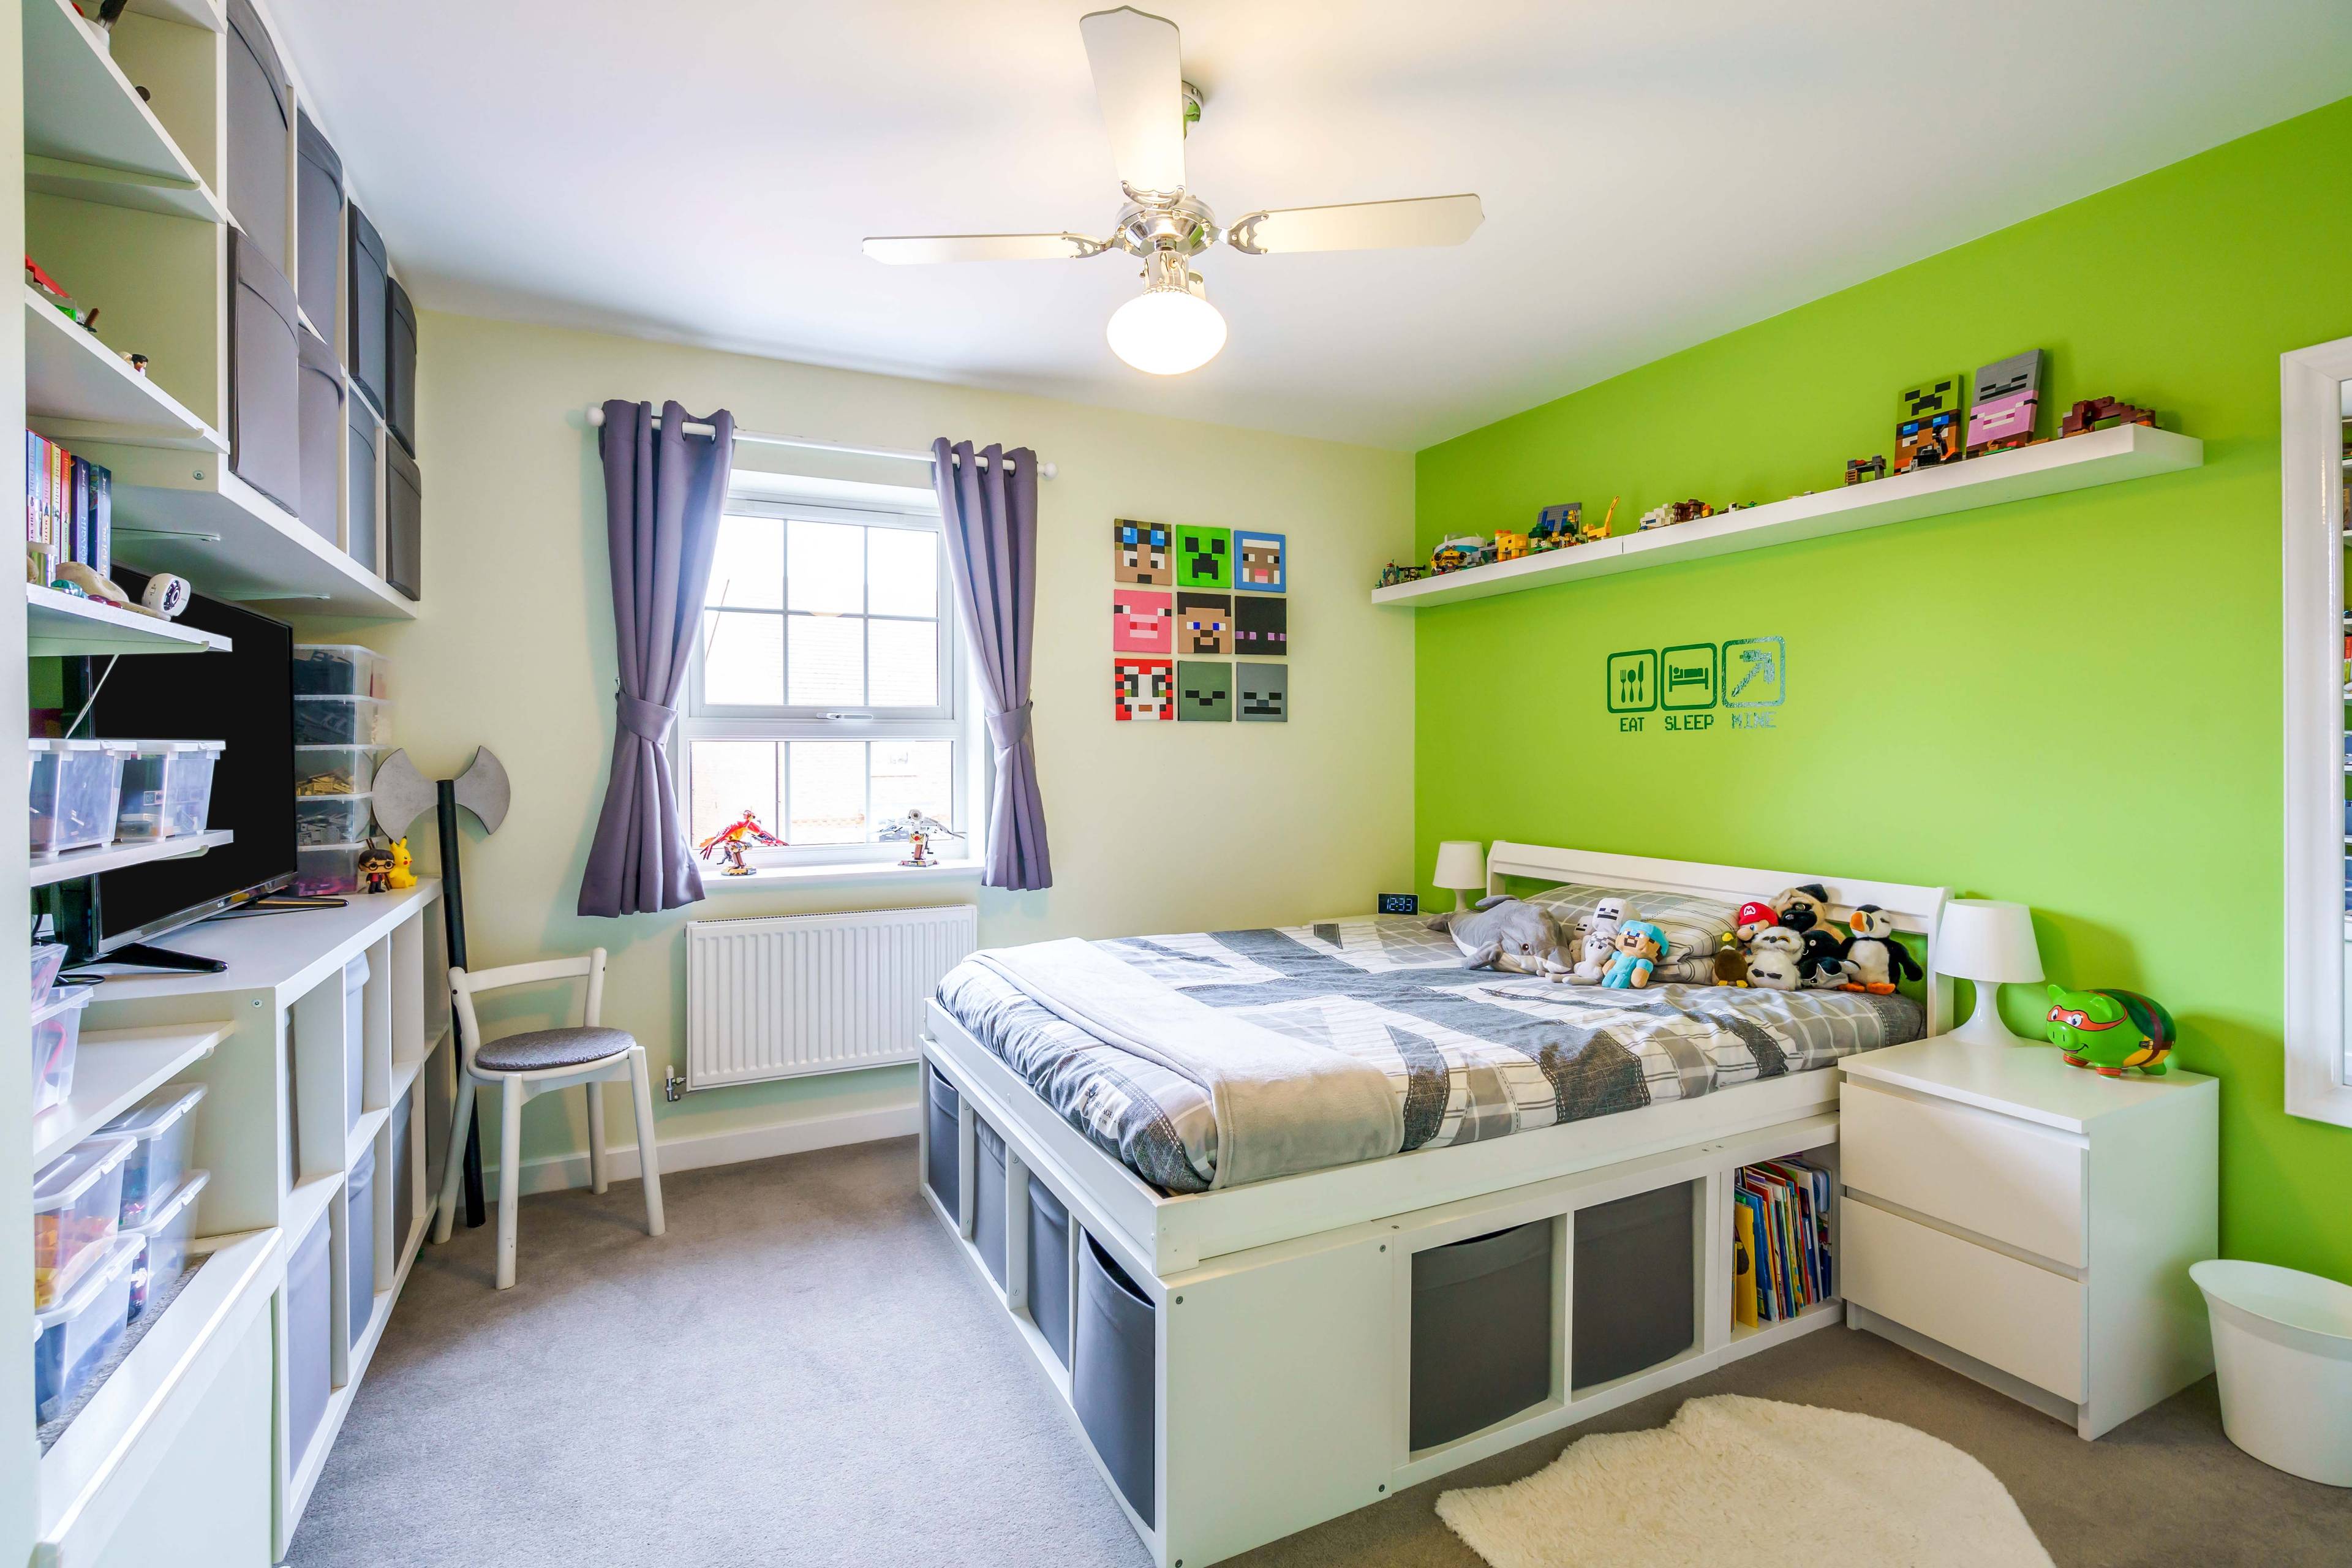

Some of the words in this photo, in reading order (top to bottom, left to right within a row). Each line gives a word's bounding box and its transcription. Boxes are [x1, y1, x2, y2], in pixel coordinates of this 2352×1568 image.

[1620, 717, 1645, 732] EAT
[1665, 714, 1714, 731] SLEEP
[1732, 711, 1776, 729] MINE
[1387, 897, 1412, 911] 12:33
